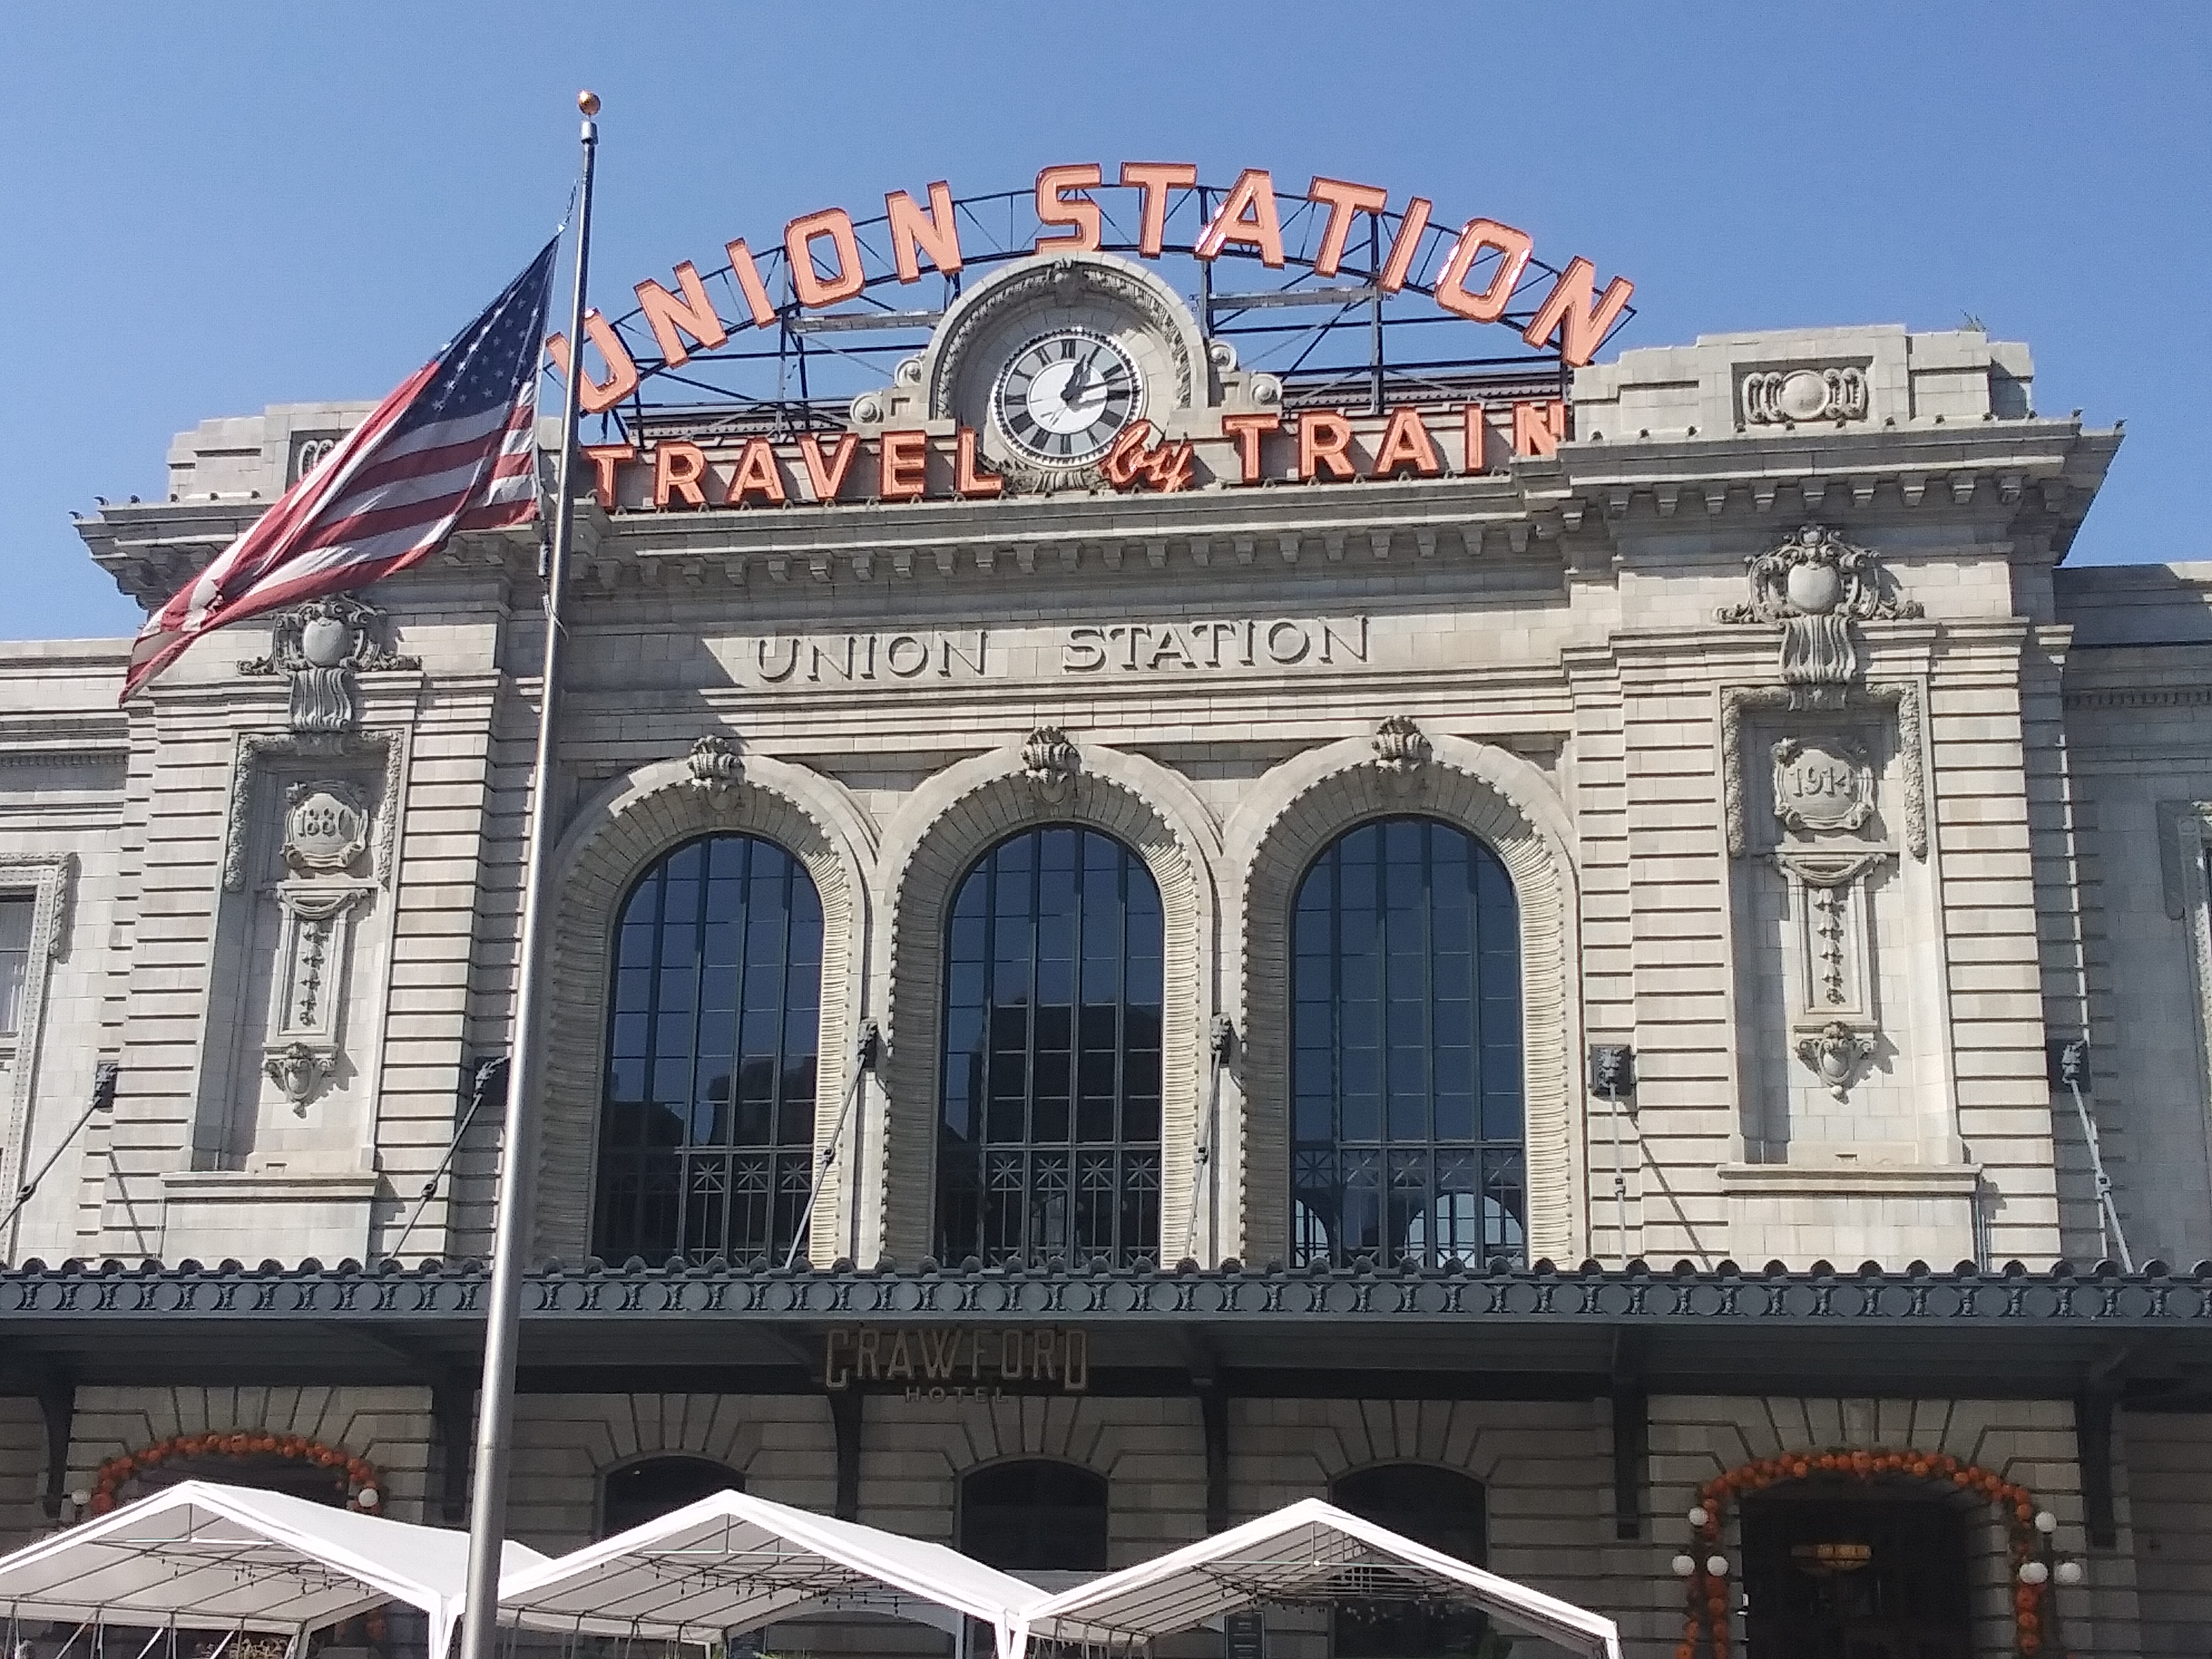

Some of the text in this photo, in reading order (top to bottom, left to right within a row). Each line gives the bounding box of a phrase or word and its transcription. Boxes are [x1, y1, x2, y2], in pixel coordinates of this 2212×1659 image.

[546, 162, 1634, 414] UNION STATION
[580, 401, 1567, 511] TRAVEL by TRAIN
[757, 615, 1368, 682] UNION STATION
[1789, 766, 1854, 798] 1914
[826, 1328, 1087, 1389] CRAWFORD
[905, 1386, 1009, 1404] HOTEL
